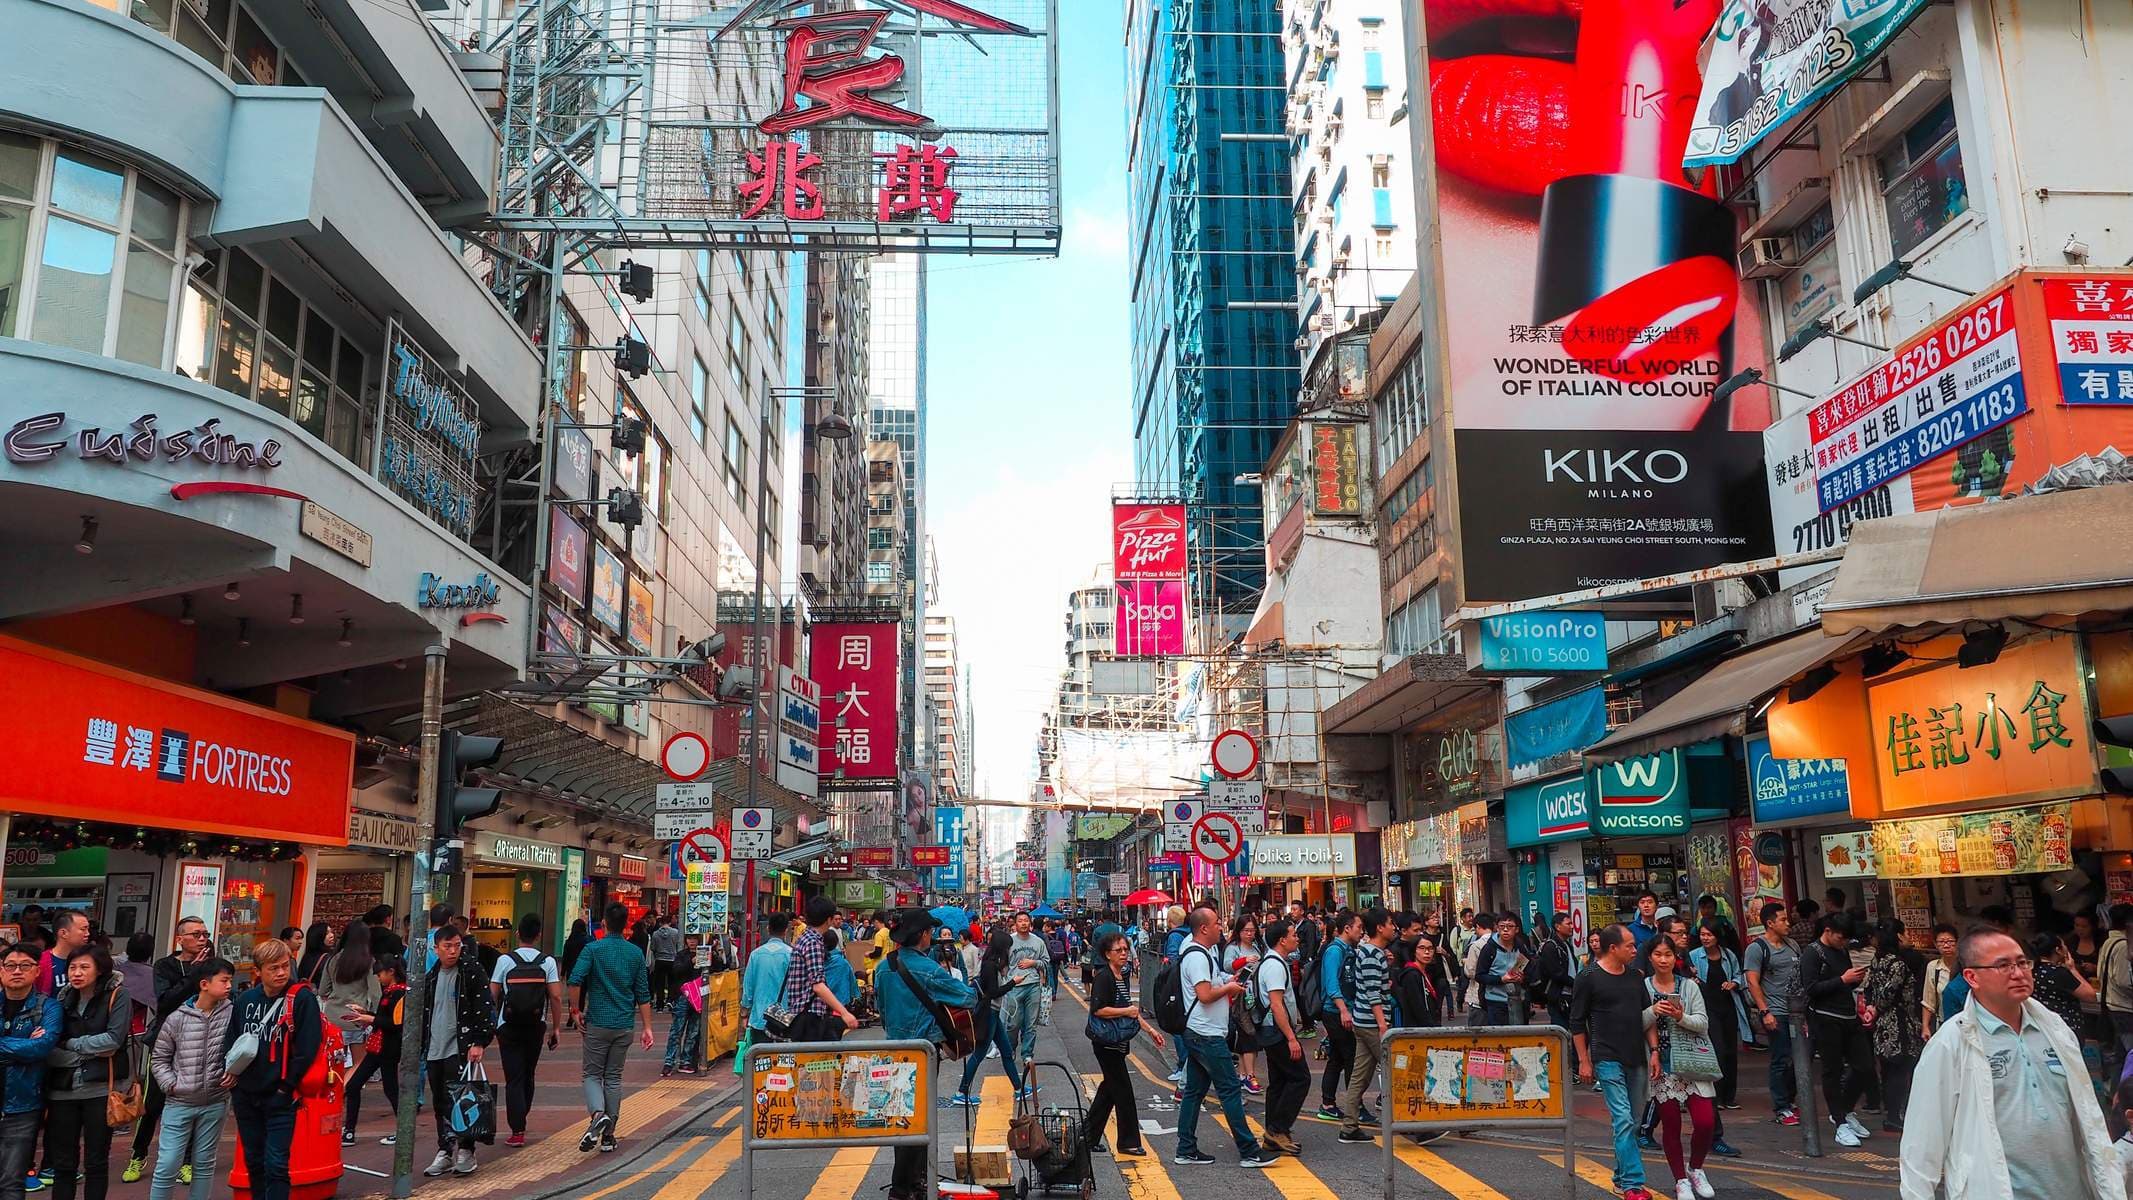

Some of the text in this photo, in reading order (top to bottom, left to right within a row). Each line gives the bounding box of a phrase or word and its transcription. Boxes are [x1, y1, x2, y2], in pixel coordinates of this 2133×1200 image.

[1787, 27, 1855, 106] 0123
[1720, 86, 1783, 154] 3182
[1508, 324, 1701, 345] 探索意大利的色彩世界
[1889, 296, 2004, 395] 2526 0267
[1494, 358, 1720, 376] WONDERFUL WORLD
[1501, 379, 1716, 398] OF ITALIAN COLOUR
[1917, 410, 1965, 456] 8202
[1967, 383, 2017, 432] 1183
[4, 412, 282, 467] Cuisine
[1342, 429, 1358, 511] TATTOO
[1544, 449, 1688, 483] KIKO
[1588, 489, 1653, 498] MILANO
[1119, 530, 1177, 556] Pizza
[1500, 536, 1525, 544] GINZA
[1526, 536, 1554, 545] PLAZA,
[1555, 536, 1569, 544] NO.
[1675, 537, 1703, 545] SOUTH,
[1793, 512, 1835, 553] 2770
[1130, 547, 1175, 569] Hut
[1489, 619, 1597, 638] VisionPro
[1500, 648, 1589, 663] 2110 5600
[837, 635, 871, 764] 周大福
[1887, 680, 2074, 776] 佳記小食
[83, 717, 154, 771] 豐澤
[191, 741, 292, 796] FORTRESS
[1758, 788, 1785, 799] STAR
[1760, 779, 1783, 790] HOT
[698, 797, 710, 805] 10
[1249, 795, 1260, 803] 10
[360, 819, 378, 844] AJI
[1600, 814, 1684, 828] watsons
[757, 833, 764, 842] 7
[757, 849, 769, 858] 12
[1298, 848, 1343, 864] Holika
[769, 1097, 786, 1107] All
